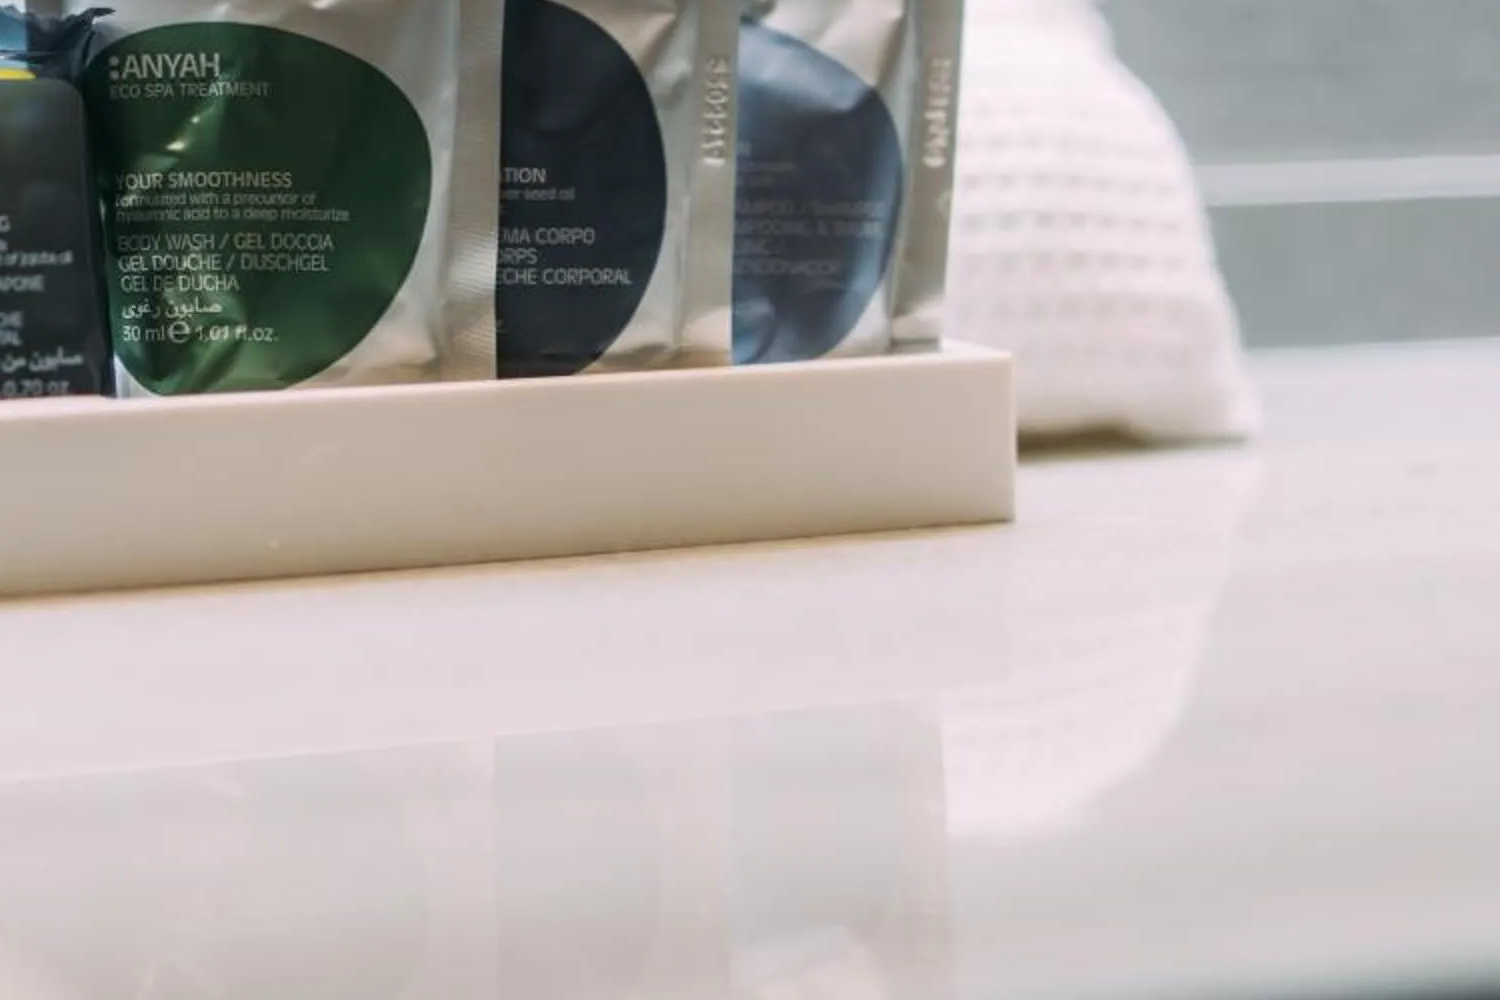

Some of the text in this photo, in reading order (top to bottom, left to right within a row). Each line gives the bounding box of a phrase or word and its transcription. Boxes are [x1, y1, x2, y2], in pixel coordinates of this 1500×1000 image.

[110, 81, 270, 99] ECO SPA TREATMENT
[118, 171, 293, 190] YOUR SMOOTHNESS
[503, 167, 547, 183] TION
[189, 191, 219, 205] with
[301, 191, 317, 205] of
[213, 208, 229, 220] to
[117, 235, 160, 251] BODY
[165, 234, 214, 250] WASH
[234, 233, 265, 250] GEL
[271, 233, 334, 250] DOCCIA
[499, 227, 595, 245] MA CORPO
[118, 254, 148, 271] GEL
[151, 253, 221, 271] DOUCHE
[241, 253, 331, 272] DUSCHGEL
[121, 274, 240, 292] GEL DE DUCHA
[496, 268, 631, 285] ECHE CORPORAL
[164, 296, 223, 319] صابون
[123, 326, 141, 341] 30
[145, 326, 165, 341] ml
